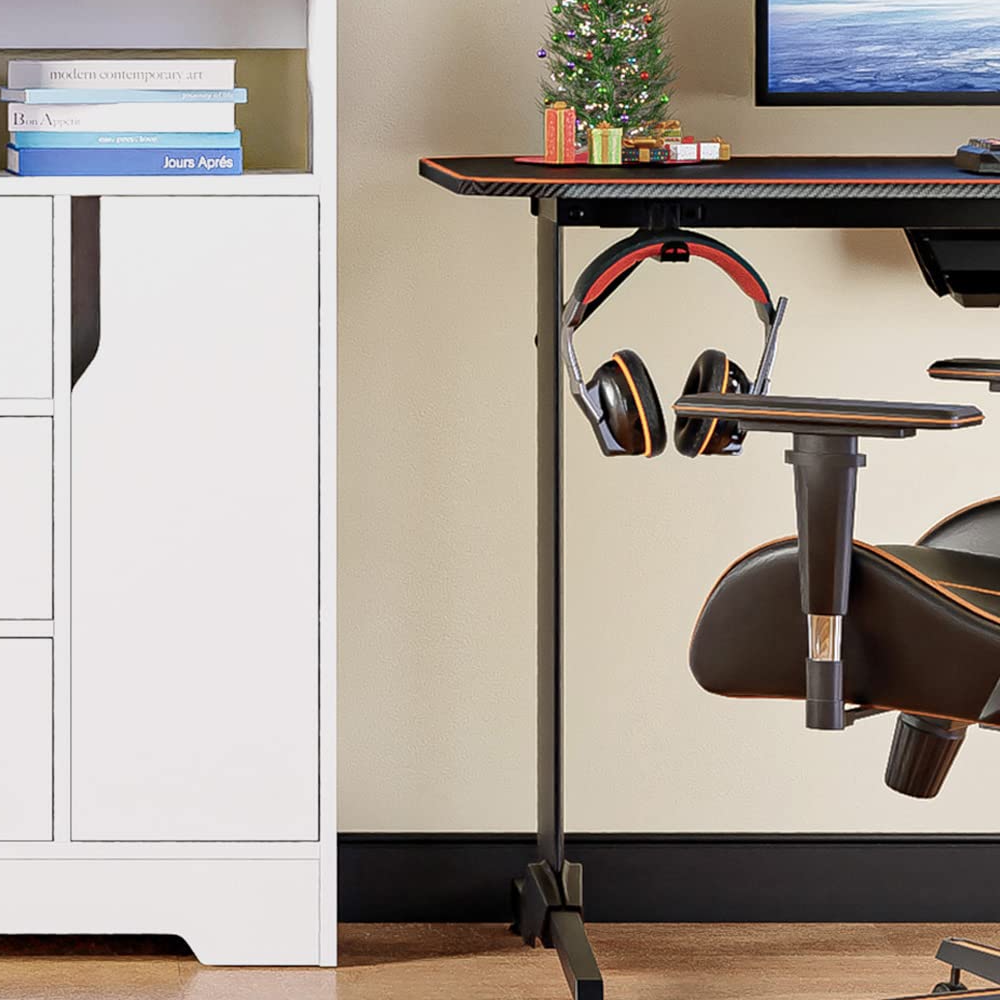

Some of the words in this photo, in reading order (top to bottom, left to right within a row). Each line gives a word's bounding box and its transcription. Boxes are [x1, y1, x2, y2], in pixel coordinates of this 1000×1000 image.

[50, 68, 96, 80] modern
[99, 70, 183, 83] contemporary
[186, 71, 203, 80] art
[13, 112, 38, 126] Bon
[163, 156, 195, 169] Jours
[197, 155, 234, 170] Aprés
